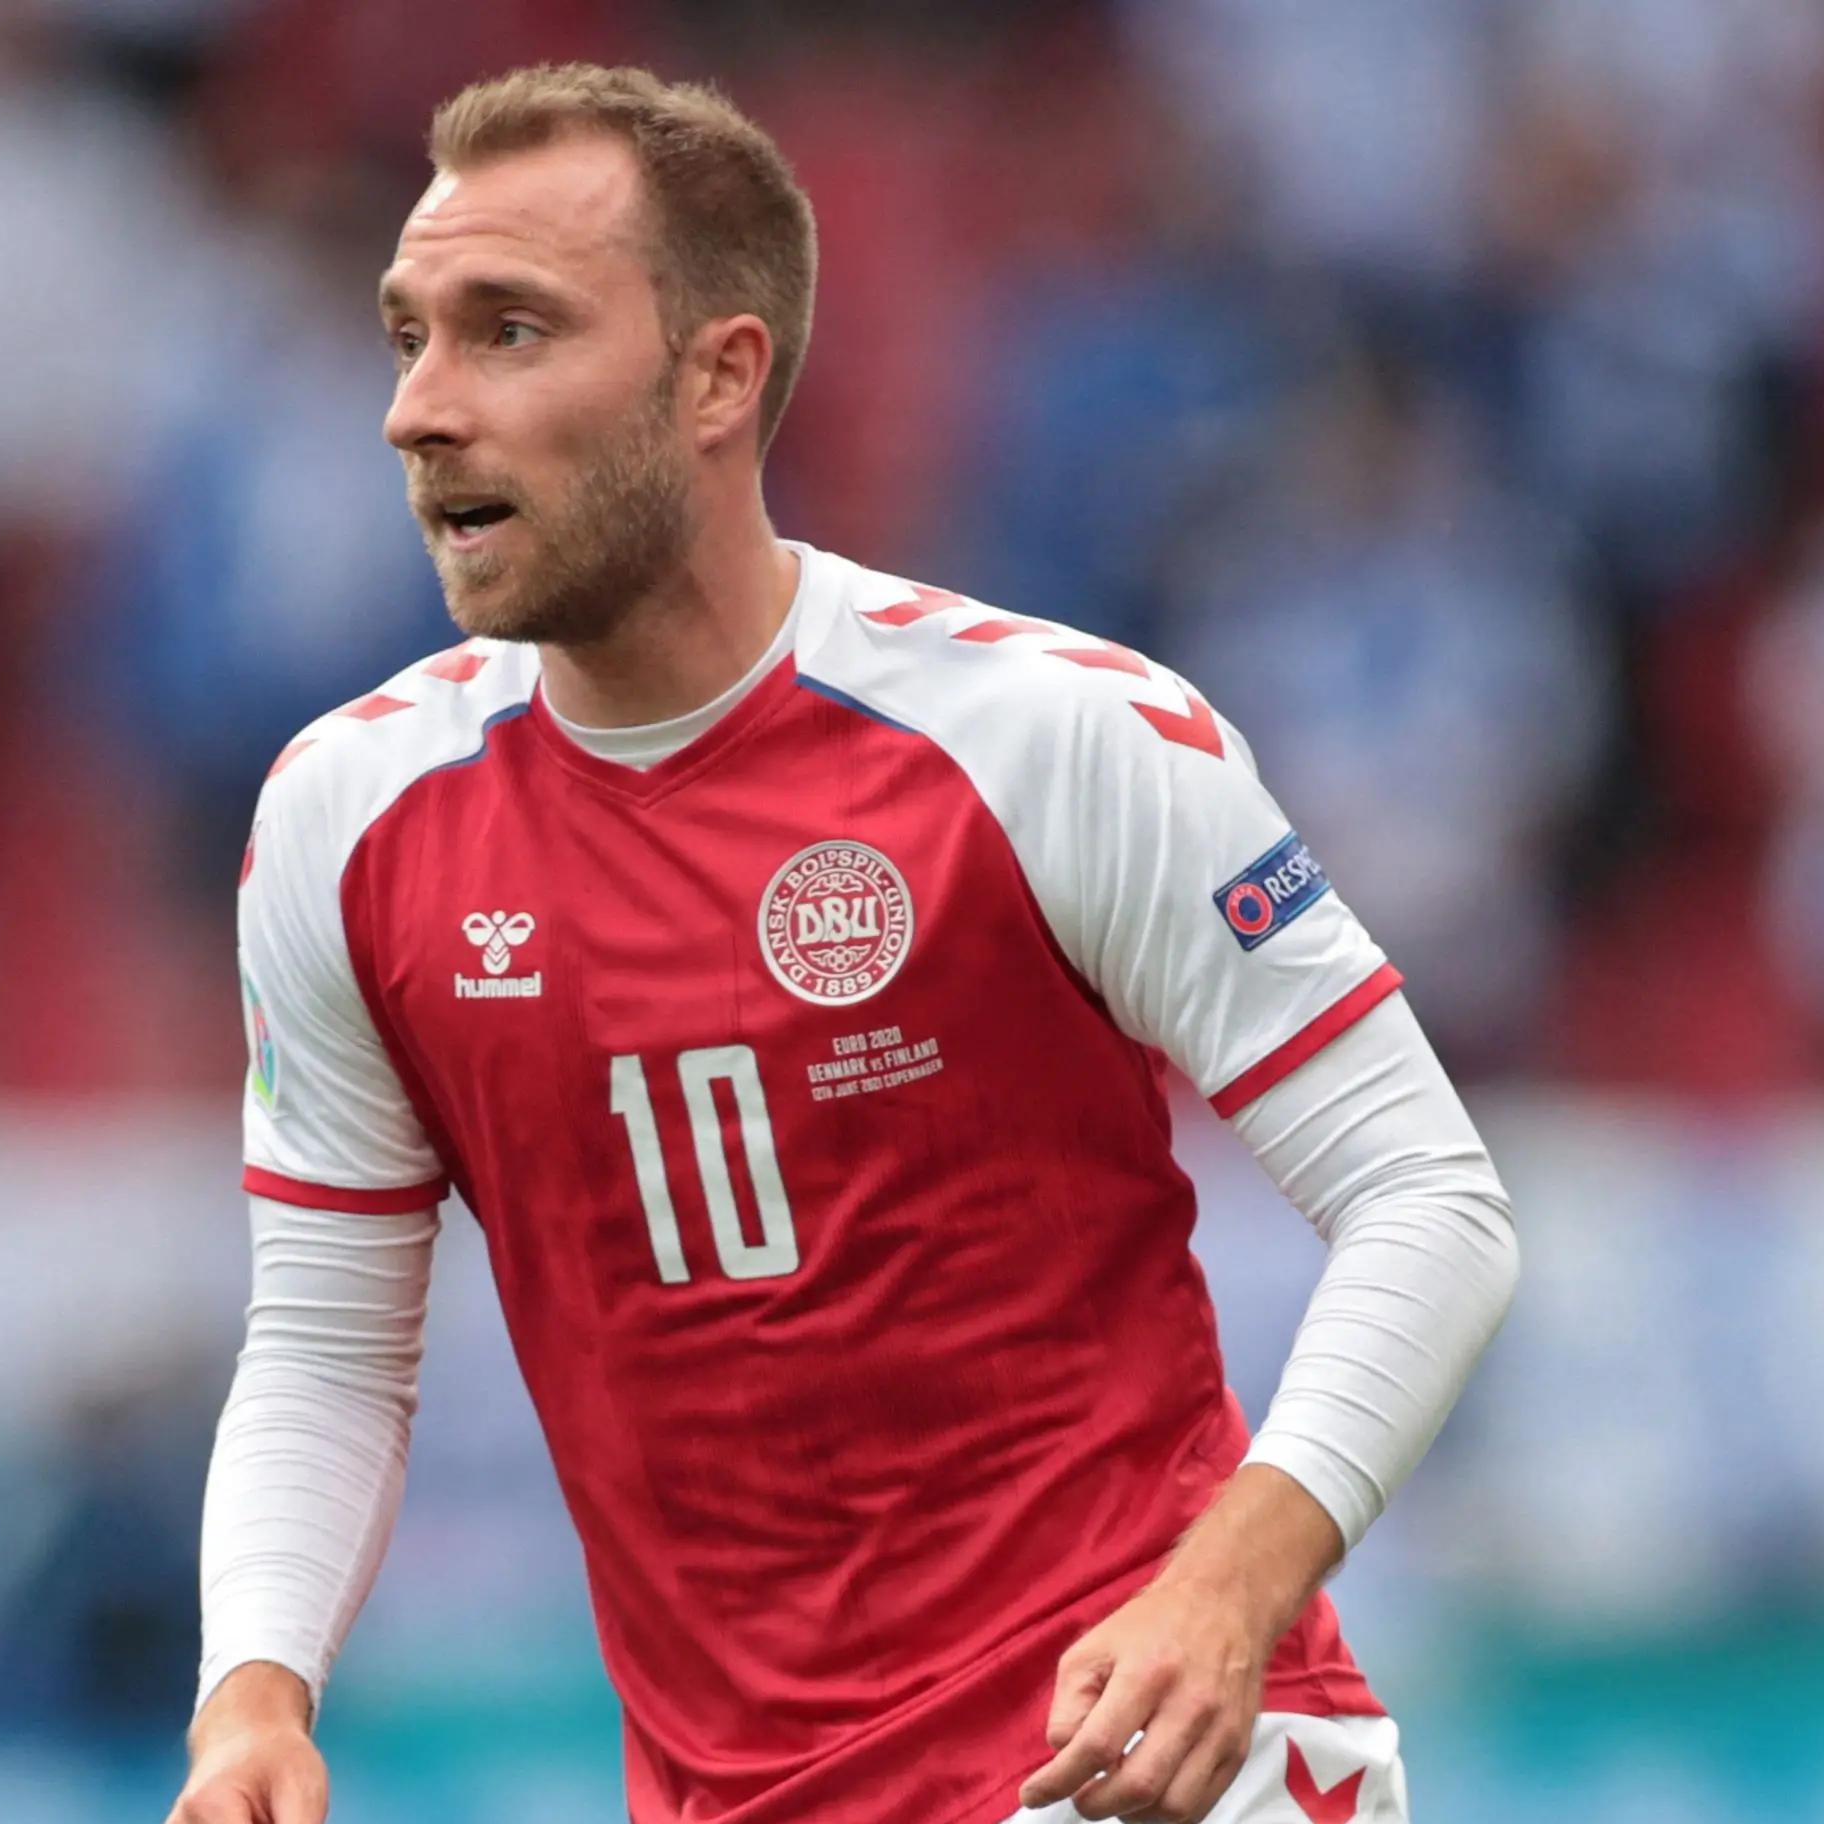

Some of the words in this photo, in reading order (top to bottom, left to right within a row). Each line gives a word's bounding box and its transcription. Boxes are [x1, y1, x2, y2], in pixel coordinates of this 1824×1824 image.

[768, 897, 809, 984] DANSK
[875, 886, 906, 969] UNION
[795, 895, 881, 945] DBU
[454, 970, 542, 999] hummel
[813, 971, 873, 996] 1889
[806, 1056, 869, 1084] DENMARK
[883, 1037, 940, 1069] FINLAND
[832, 1032, 868, 1057] EURO
[868, 1025, 903, 1049] 2020
[609, 1043, 800, 1285] 10
